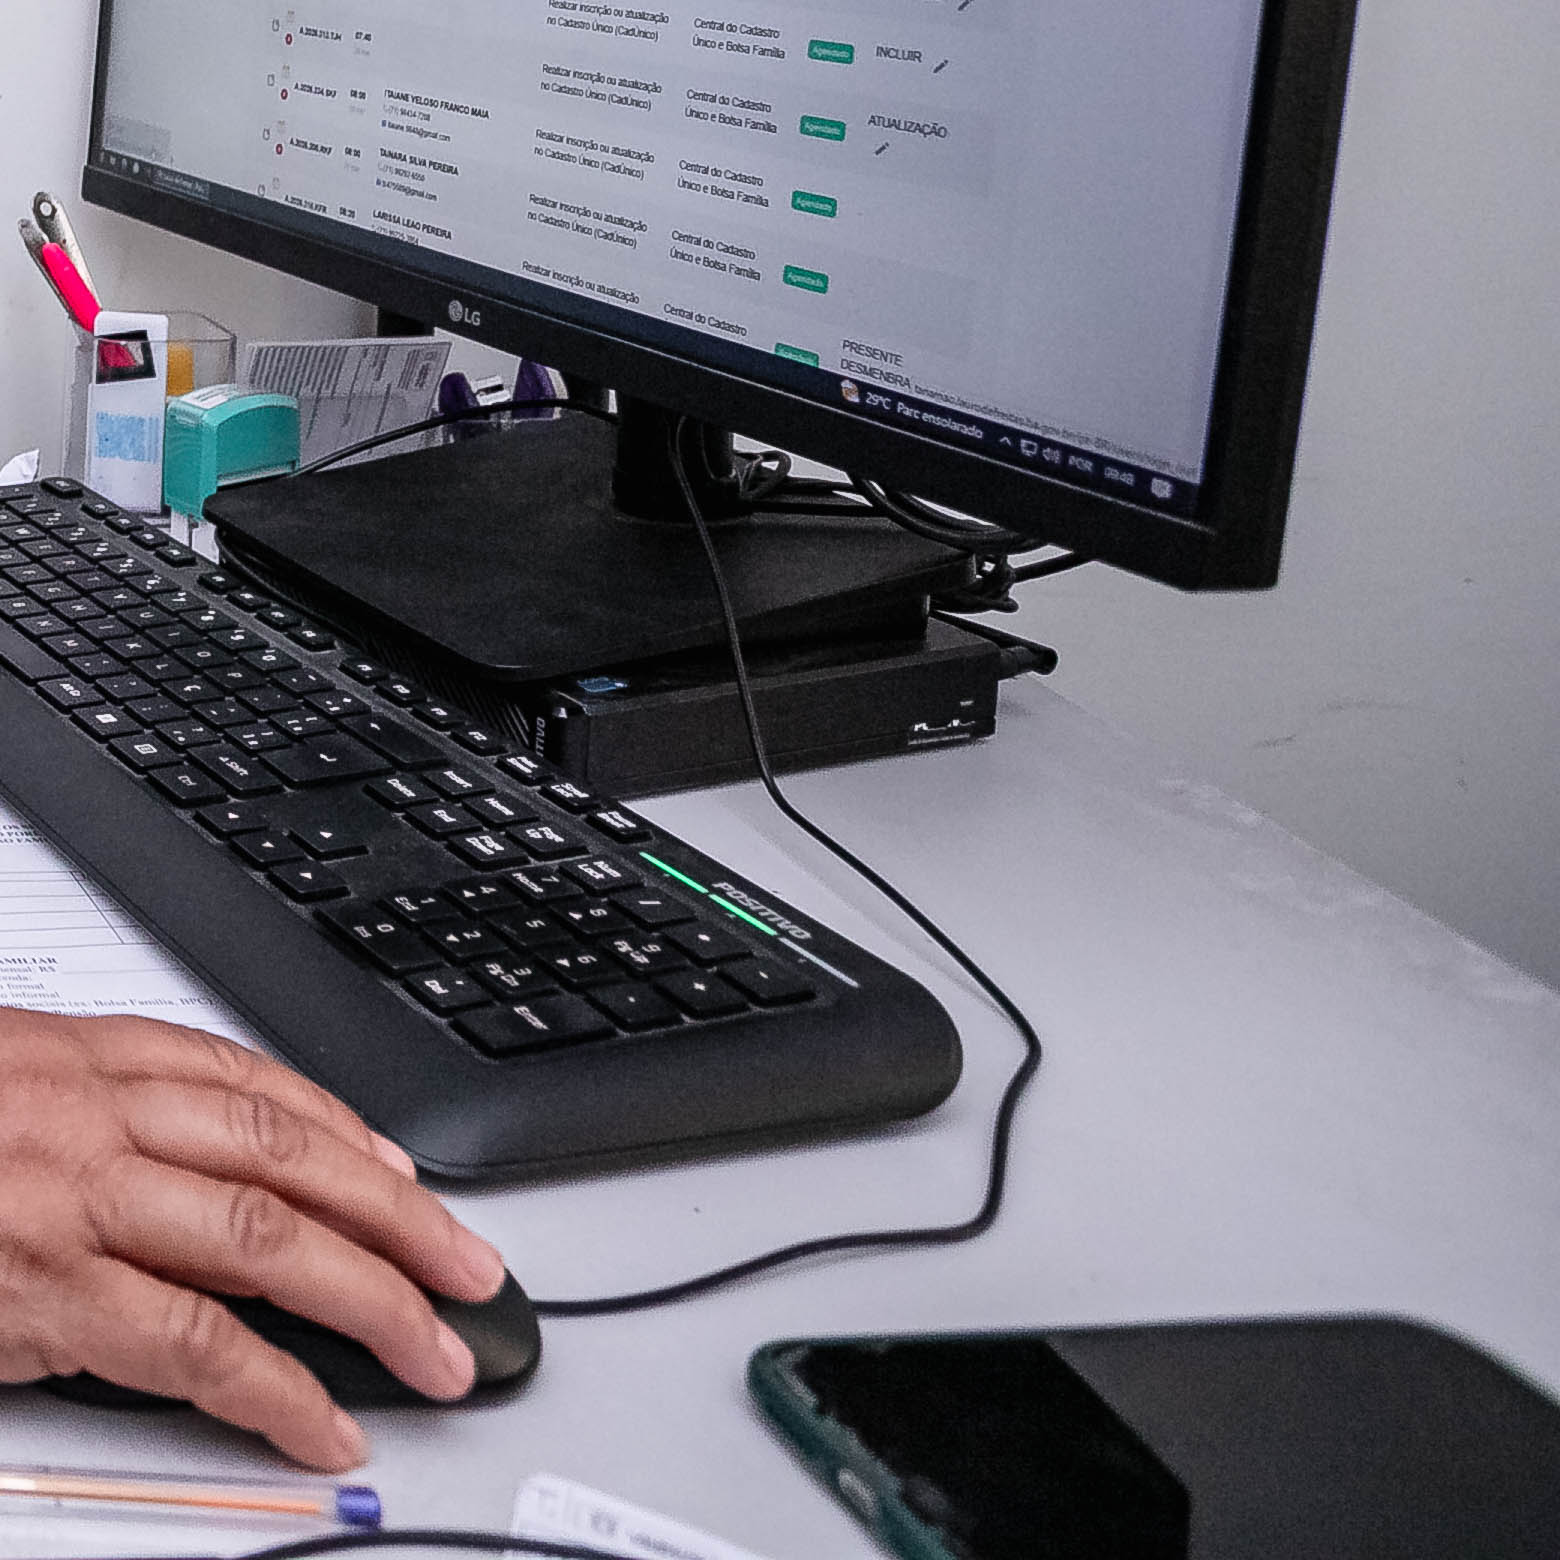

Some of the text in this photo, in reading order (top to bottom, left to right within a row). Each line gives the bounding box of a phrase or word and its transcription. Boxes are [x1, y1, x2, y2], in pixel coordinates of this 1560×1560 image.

[614, 9, 622, 17] ou
[558, 18, 590, 30] Cadastro
[694, 18, 779, 37] Central do Cadastro
[693, 36, 716, 49] Único
[726, 41, 750, 54] Bolsa
[753, 44, 786, 58] Família
[876, 47, 922, 62] INCLUIR
[440, 101, 469, 114] FRANCO
[687, 90, 772, 112] Central do Cadastro
[685, 108, 708, 121] Único
[719, 114, 742, 127] Bolsa
[745, 118, 777, 133] Família
[869, 116, 947, 138] ATUALIZAÇÃO
[534, 149, 543, 157] no
[545, 148, 577, 164] Cadastro
[600, 144, 609, 153] ou
[679, 160, 763, 186] Central do Cadastro
[678, 178, 701, 192] Único
[711, 186, 734, 199] Bolsa
[737, 191, 769, 207] Família
[672, 230, 755, 259] Central do Cadastro
[463, 308, 481, 327] LG
[842, 340, 903, 367] PRESENTE
[866, 391, 891, 411] 29°C
[897, 401, 920, 420] Parc
[921, 409, 983, 439] ensolarado
[443, 770, 472, 789] Insert
[484, 797, 514, 816] Home
[712, 882, 812, 940] POSITIVO
